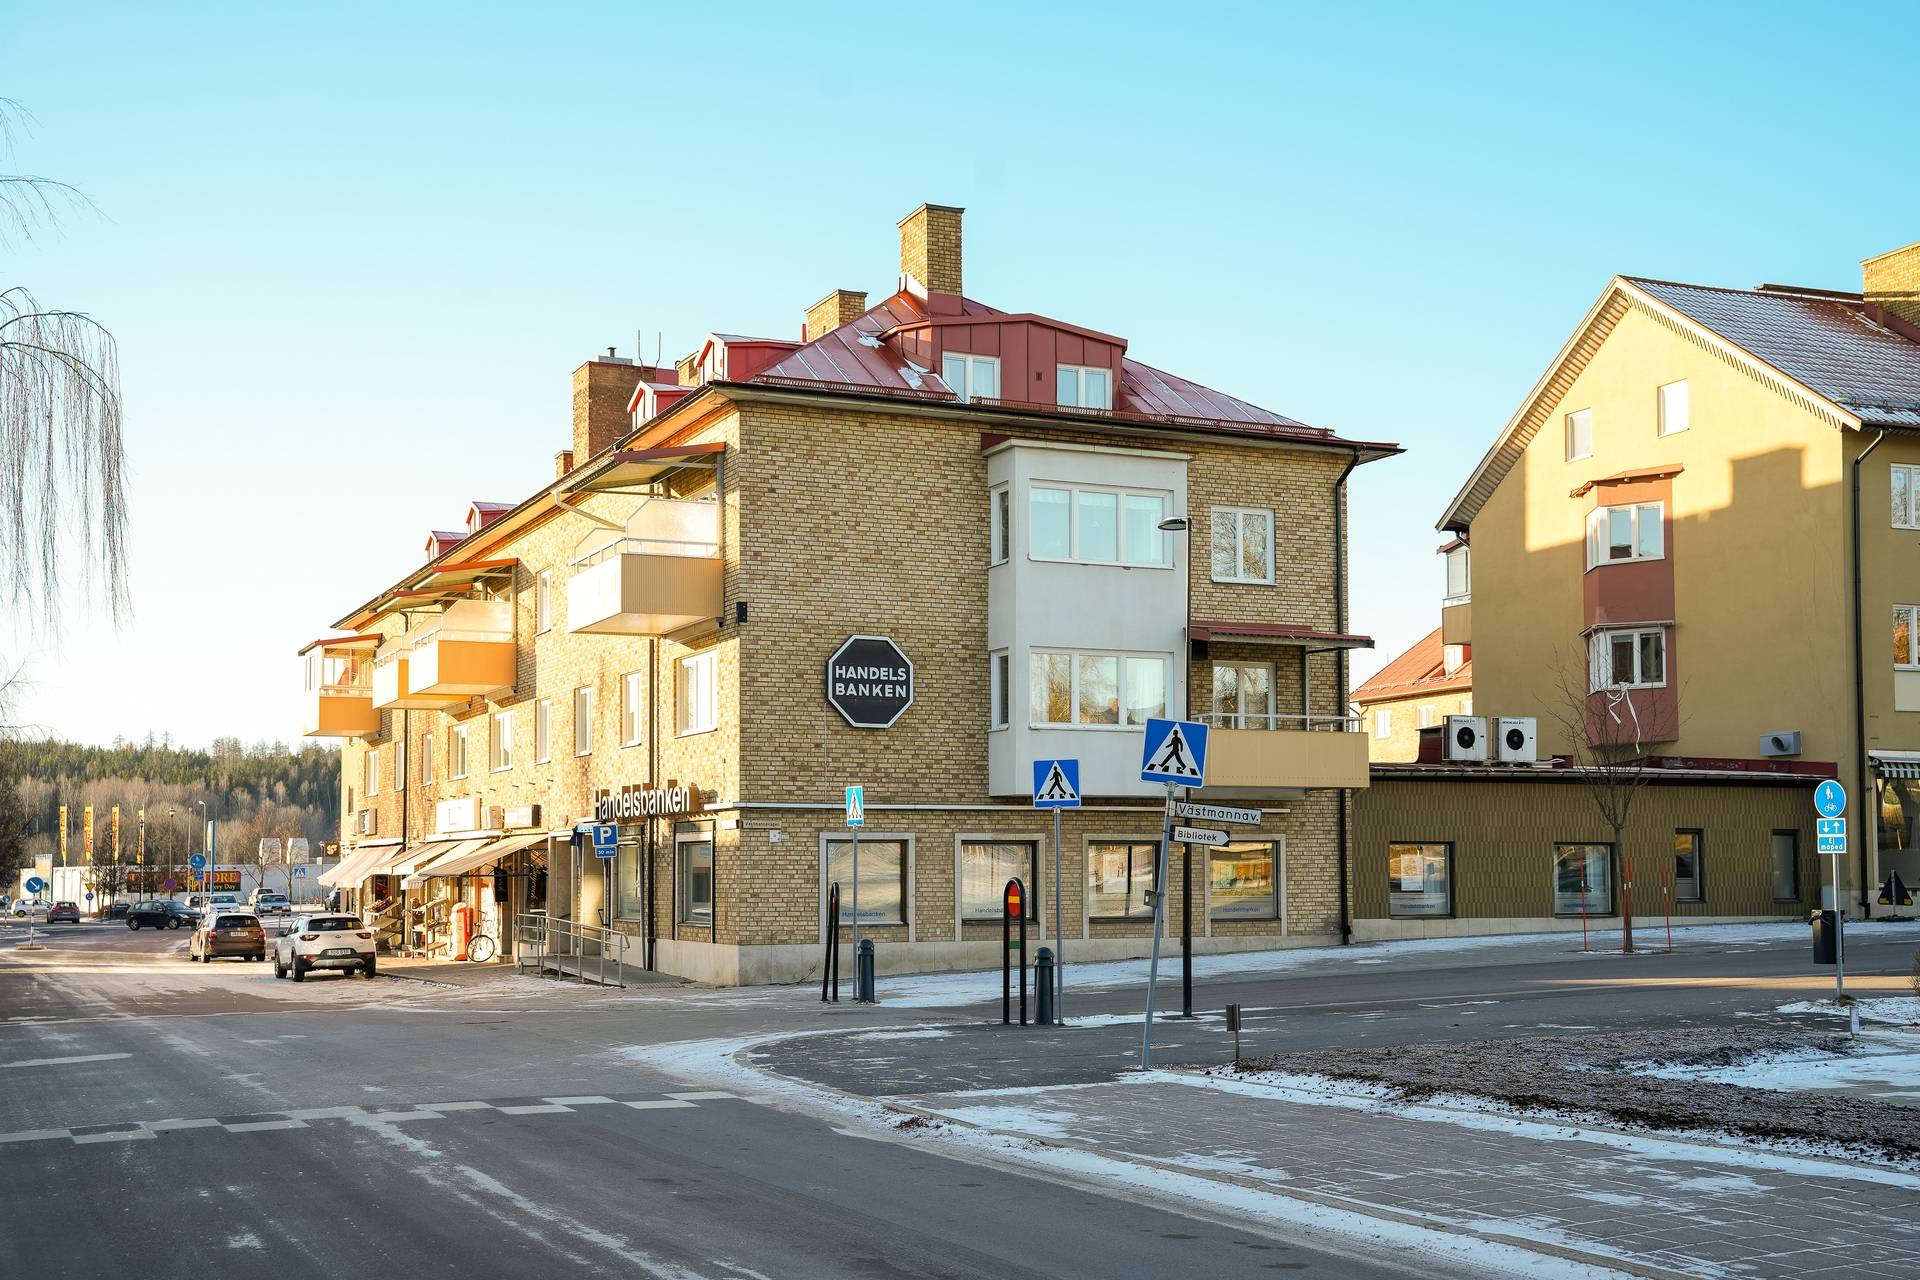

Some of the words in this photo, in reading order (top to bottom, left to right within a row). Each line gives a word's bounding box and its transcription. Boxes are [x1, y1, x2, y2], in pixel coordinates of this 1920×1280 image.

[835, 665, 907, 681] HANDELS
[835, 682, 907, 698] BANKEN
[595, 786, 690, 820] Handelsbanken
[1179, 804, 1259, 822] Västmannav.
[600, 826, 612, 844] P
[1177, 830, 1217, 842] Bibliotek
[1828, 837, 1835, 845] Ej
[1820, 843, 1843, 851] moped
